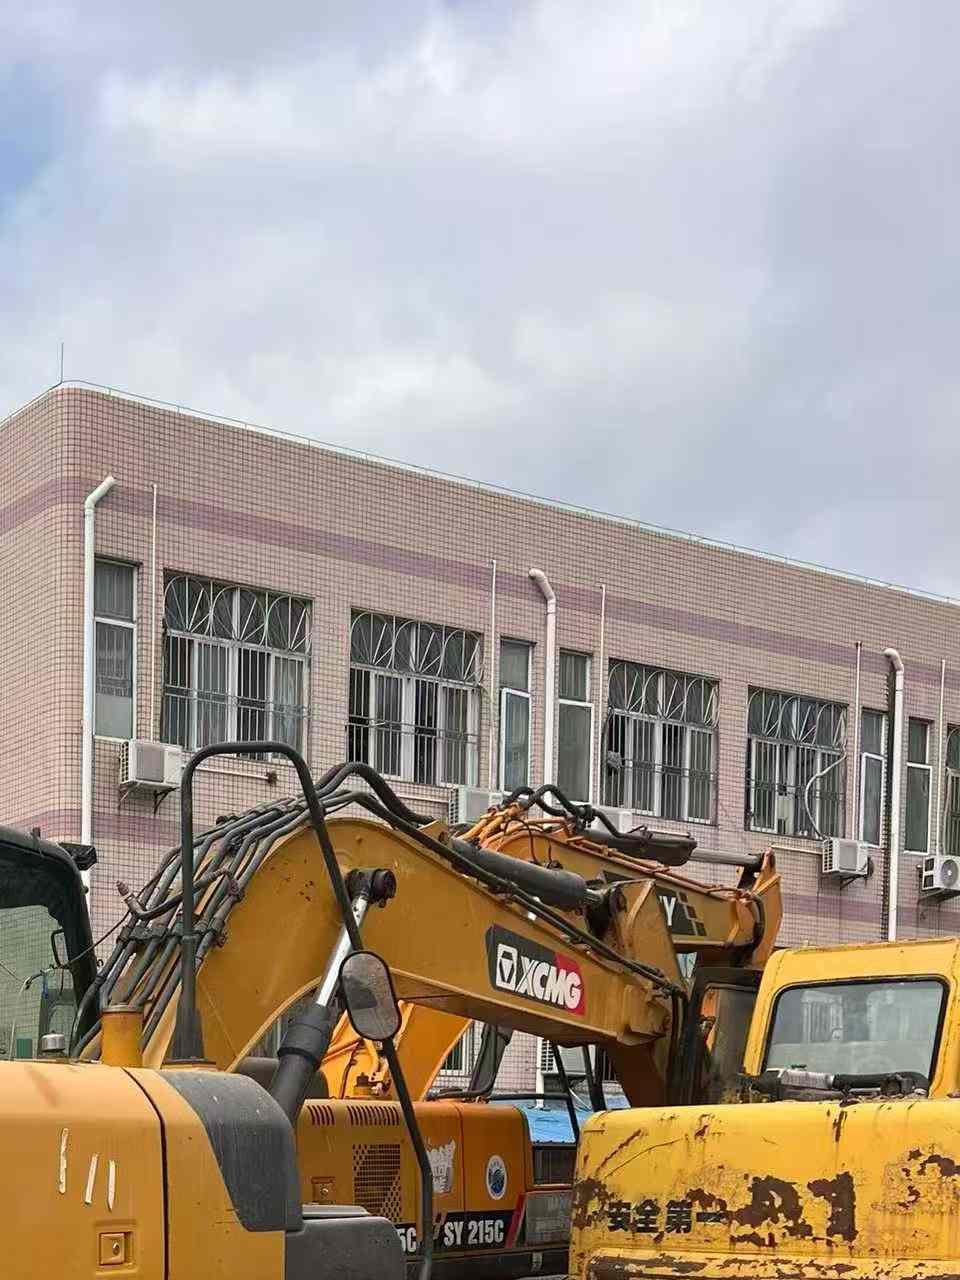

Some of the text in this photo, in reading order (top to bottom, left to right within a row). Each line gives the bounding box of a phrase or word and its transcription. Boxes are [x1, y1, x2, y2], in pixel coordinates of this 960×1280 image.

[515, 957, 582, 1009] XCMG
[444, 1219, 505, 1247] SY 215C
[607, 1199, 724, 1234] 安全第一
